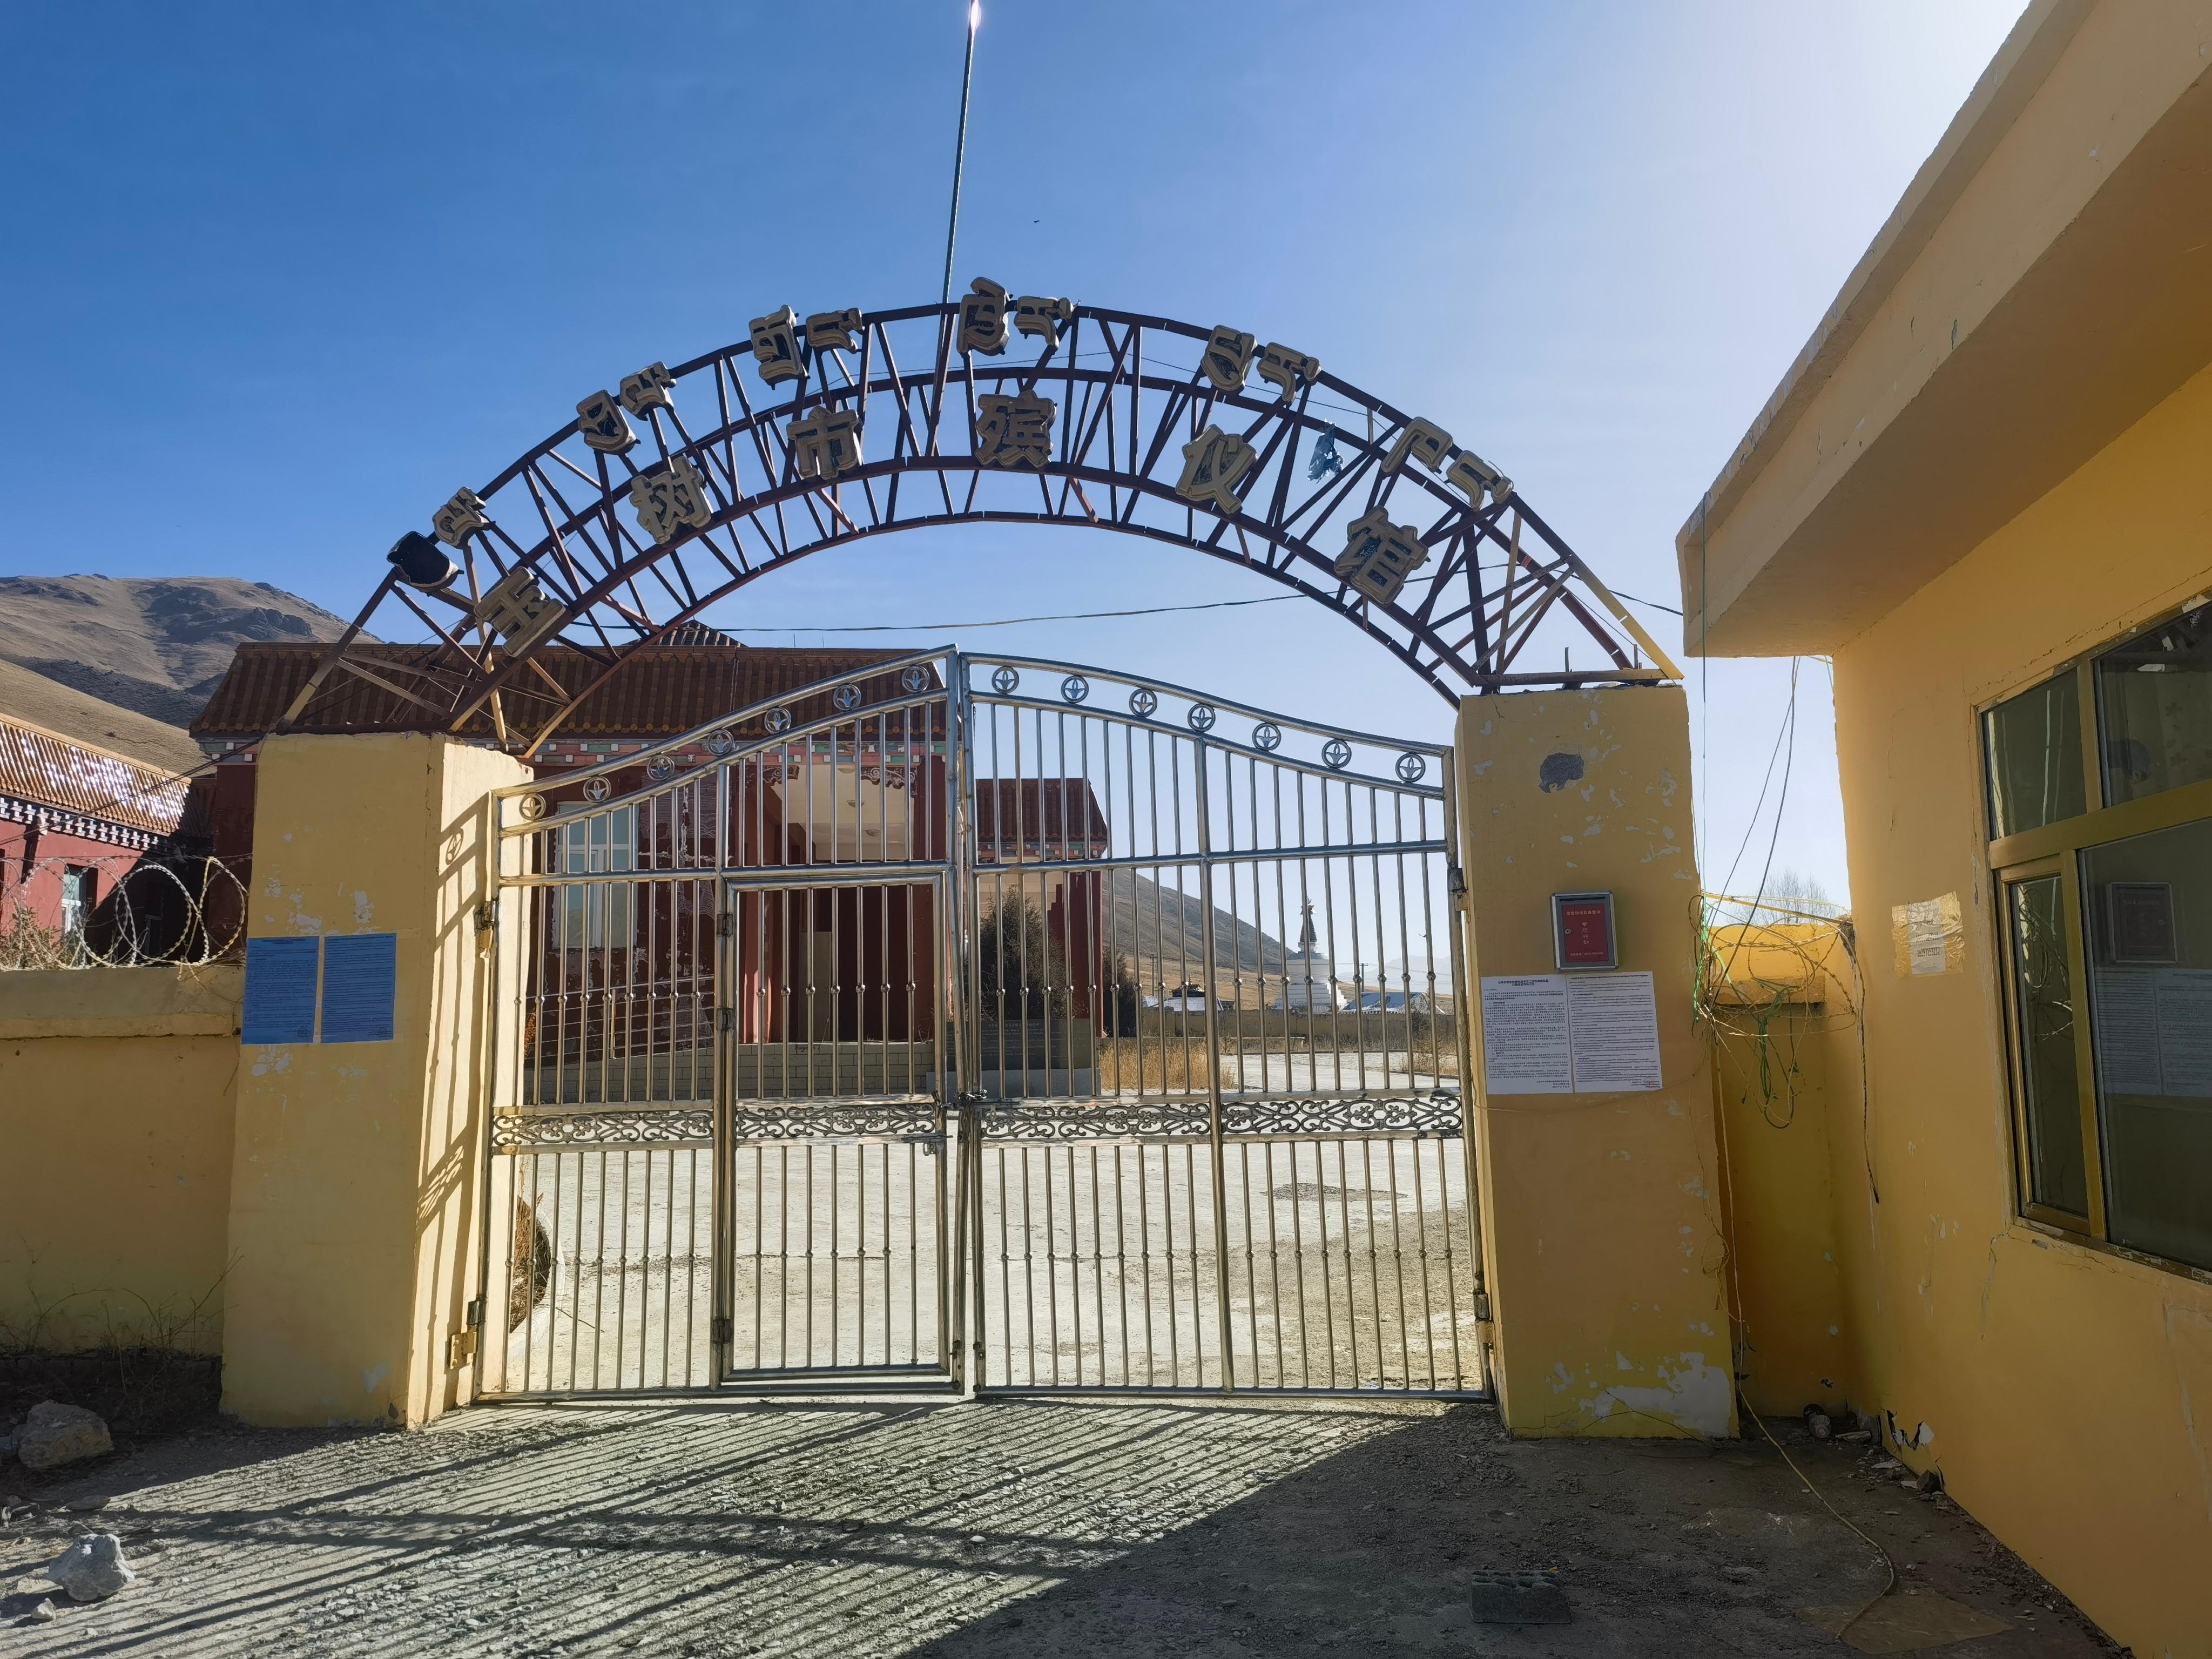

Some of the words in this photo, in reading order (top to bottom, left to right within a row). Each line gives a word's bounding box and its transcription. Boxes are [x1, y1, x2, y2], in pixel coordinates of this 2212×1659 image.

[474, 390, 1428, 657] 玉树市殡仪馆
